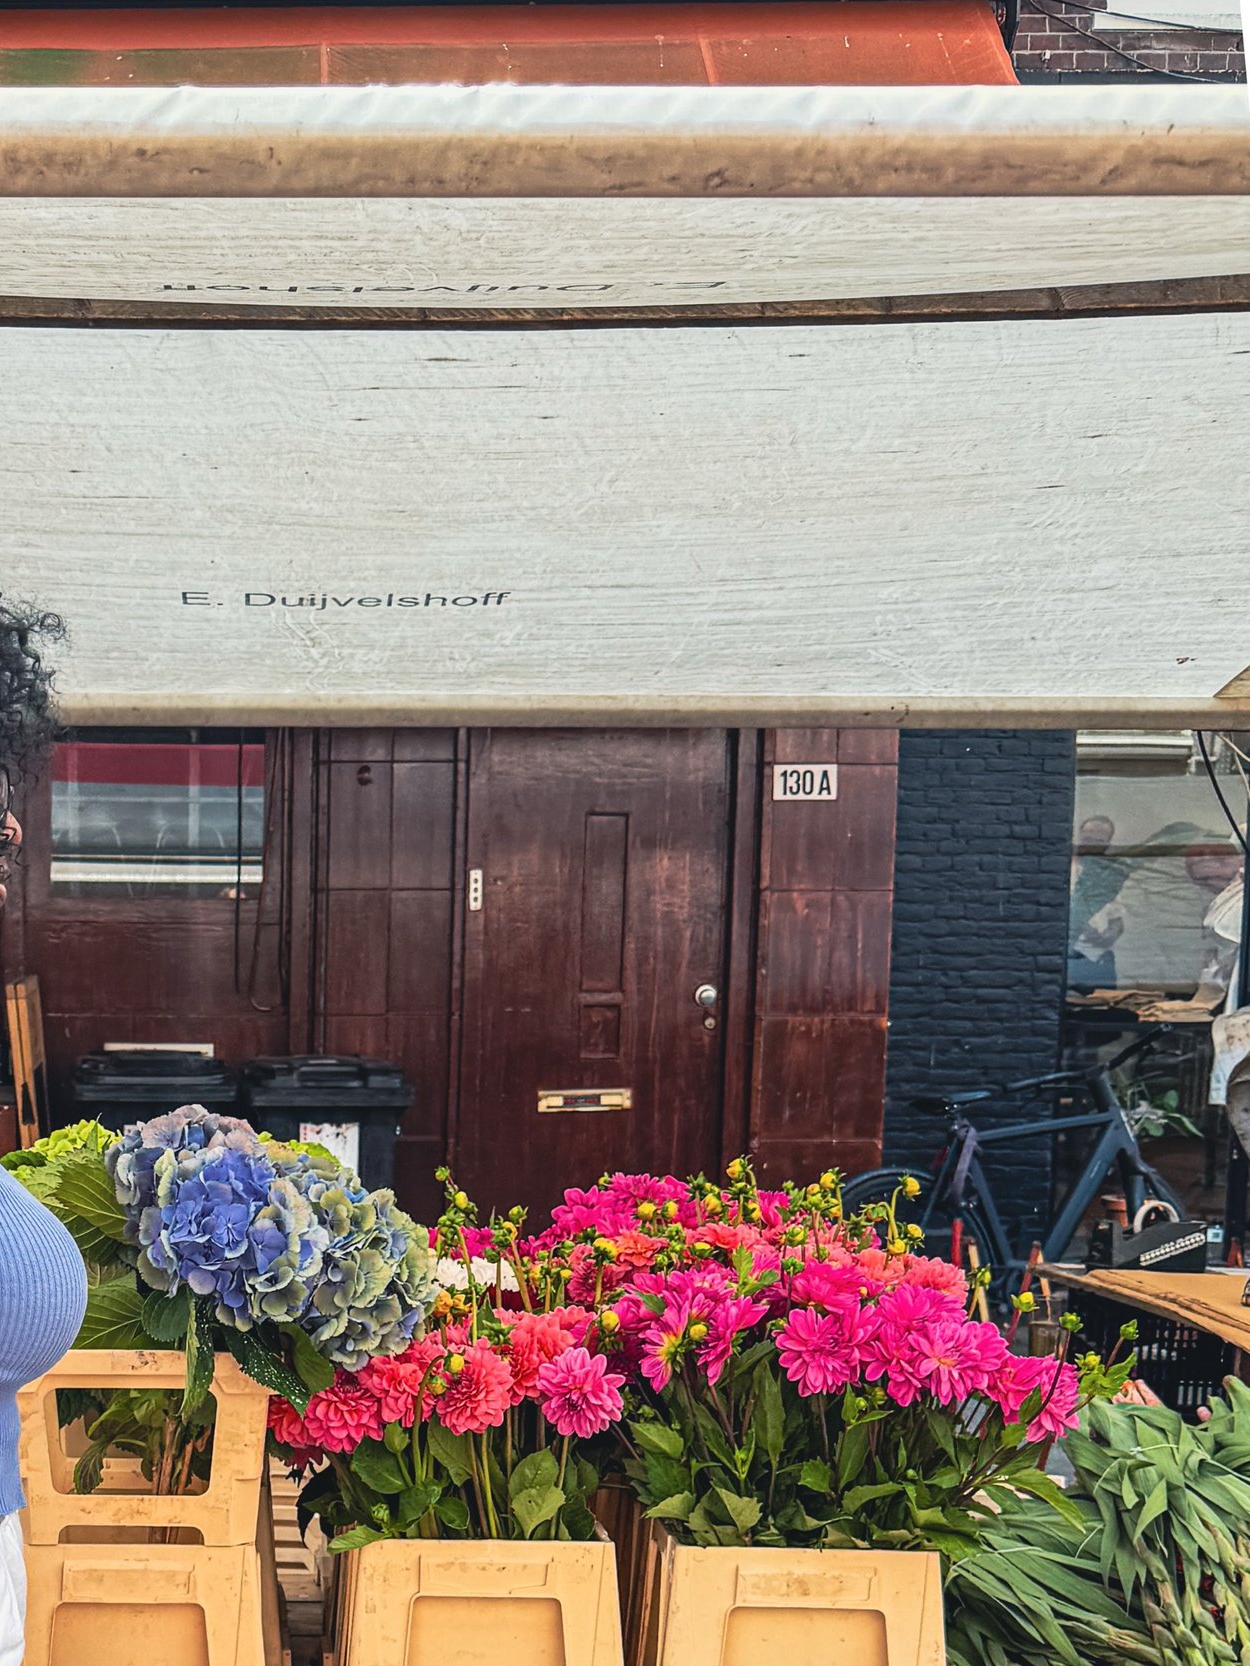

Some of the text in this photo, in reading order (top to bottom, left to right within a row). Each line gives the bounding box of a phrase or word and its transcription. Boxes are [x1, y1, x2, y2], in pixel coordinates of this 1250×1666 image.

[181, 591, 511, 610] E. Duijvelshoff
[780, 770, 831, 796] 130 A
